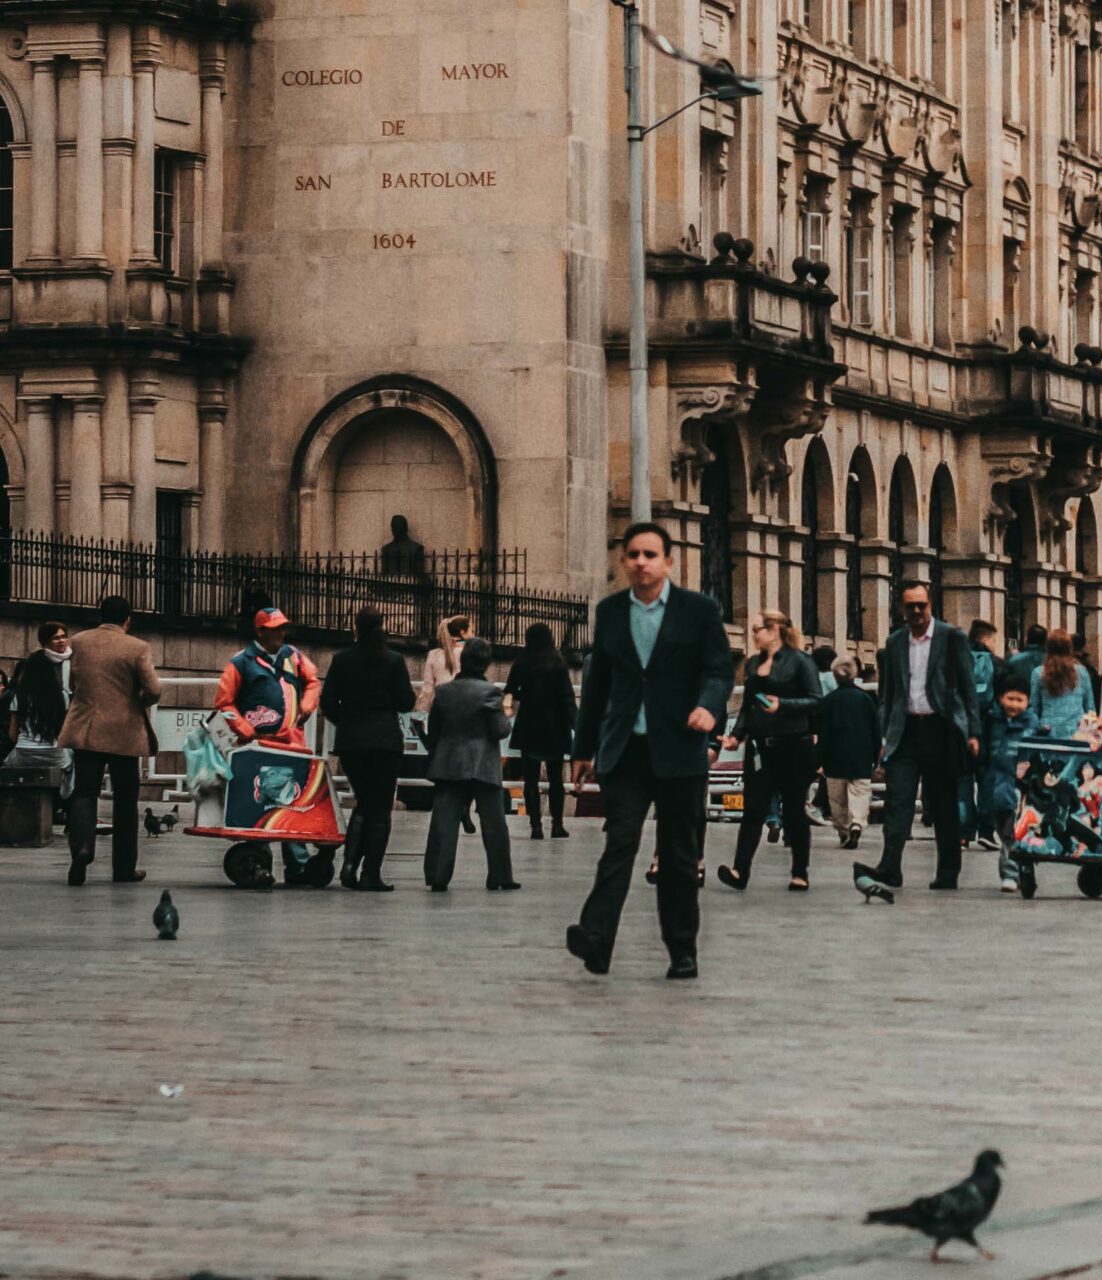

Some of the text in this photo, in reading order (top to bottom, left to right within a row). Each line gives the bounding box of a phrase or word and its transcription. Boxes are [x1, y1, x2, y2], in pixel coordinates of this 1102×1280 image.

[281, 63, 510, 87] COLEGIO MAYOR
[381, 120, 406, 137] DE
[295, 171, 497, 191] SAN BARTOLOME
[372, 234, 417, 249] 1604
